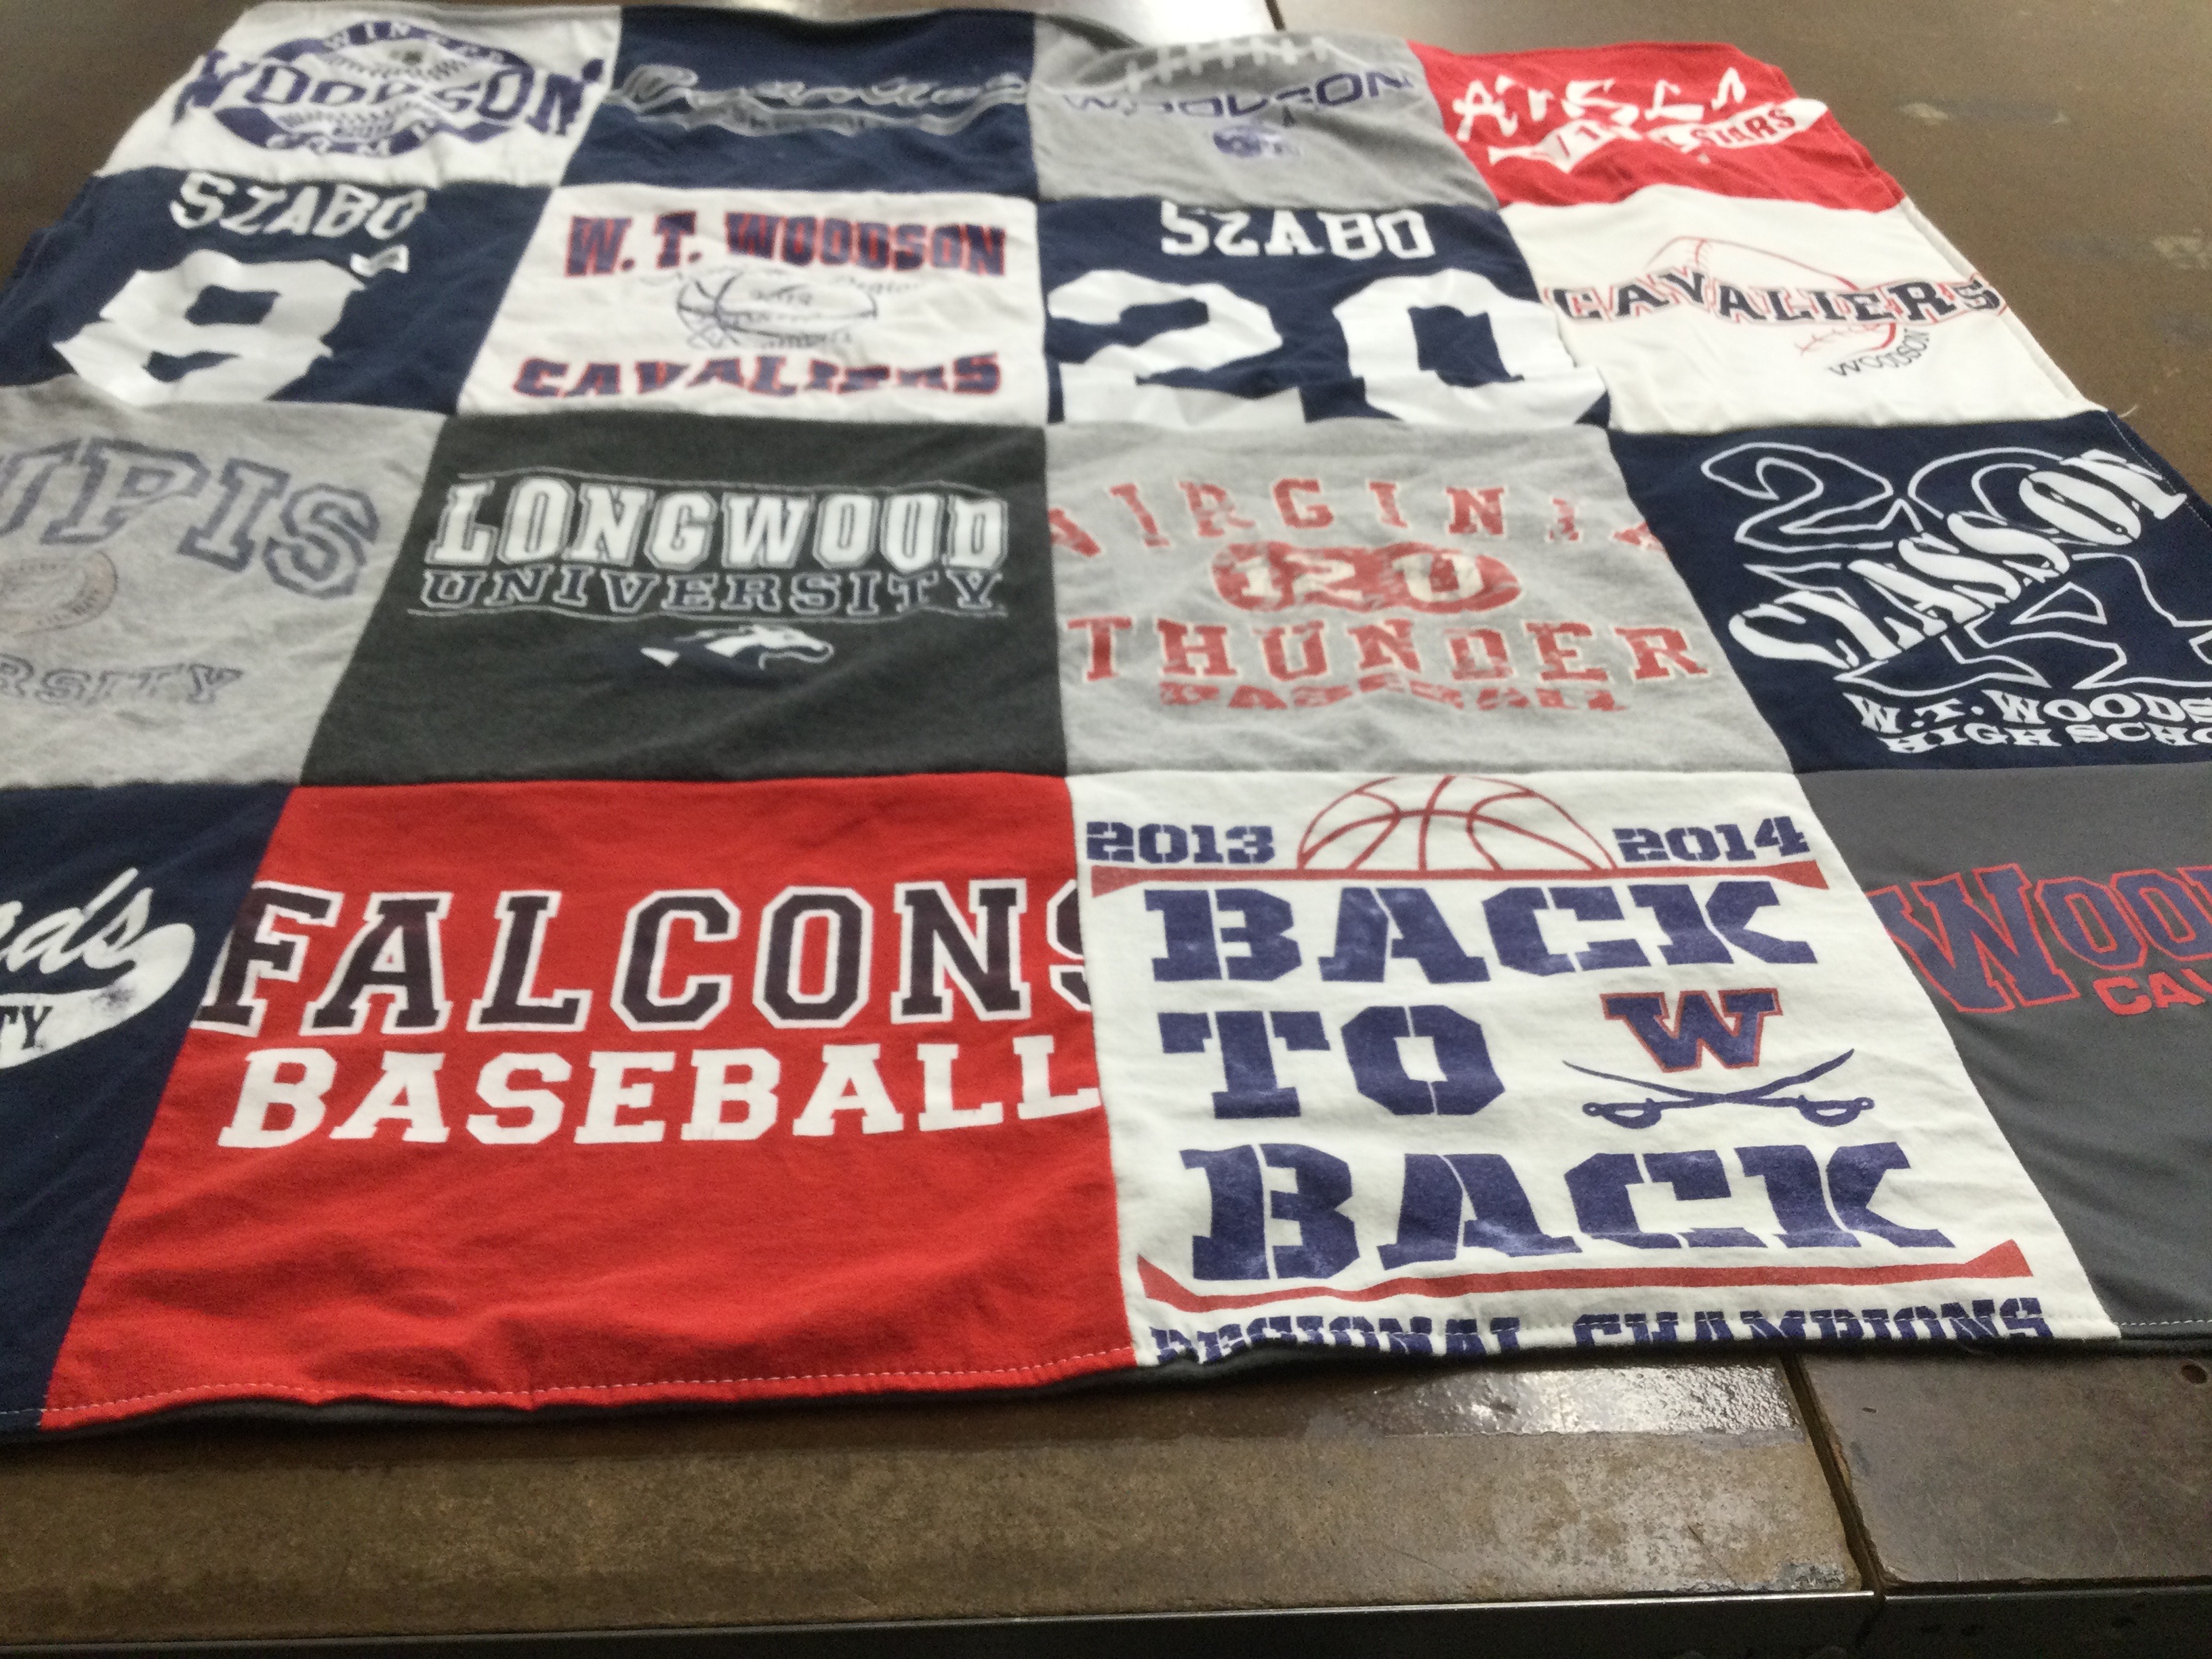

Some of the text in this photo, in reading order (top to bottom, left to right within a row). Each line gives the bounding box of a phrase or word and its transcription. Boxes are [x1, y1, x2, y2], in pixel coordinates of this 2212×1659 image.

[169, 171, 428, 239] SZABO
[724, 211, 1006, 276] WOODSON
[1160, 201, 1435, 260] SZABO
[1544, 266, 2007, 325] CAVALIERS
[1047, 269, 1607, 428] 20
[424, 477, 1008, 571] LONGWOOD
[421, 565, 1003, 615] UNIVERSITY
[1066, 615, 1709, 683] THUNDER
[1878, 722, 2062, 754] HIGH
[1086, 815, 1811, 864] 2013 2014
[1144, 881, 1818, 985] BACK
[1865, 863, 2212, 1014] WOO
[1158, 1005, 1506, 1120] TO
[1599, 987, 1782, 1073] W
[216, 1034, 1101, 1148] BASEBALL
[1179, 1141, 1957, 1280] BACK
